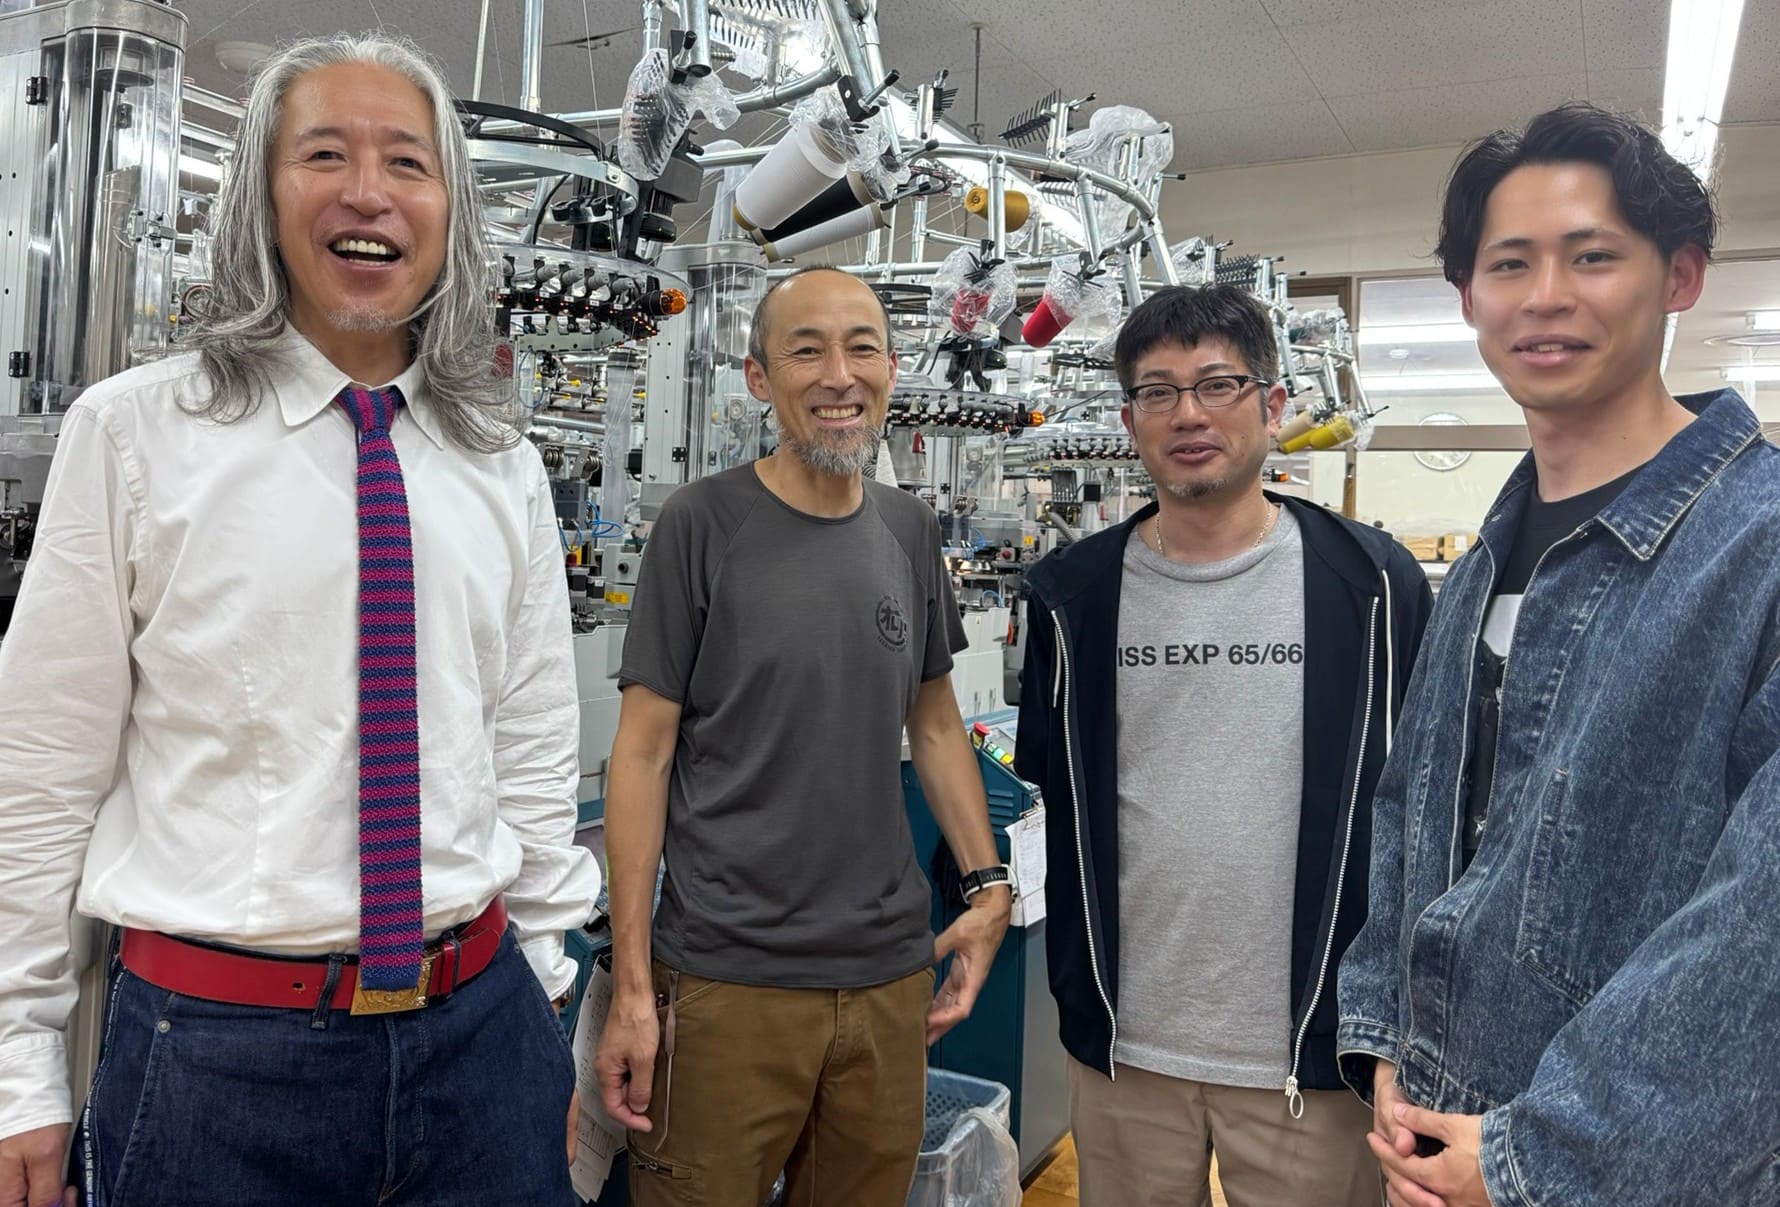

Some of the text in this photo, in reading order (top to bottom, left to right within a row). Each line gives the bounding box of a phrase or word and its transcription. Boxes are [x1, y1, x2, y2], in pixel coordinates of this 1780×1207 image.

[1118, 643, 1303, 667] ISS EXP 65/66
